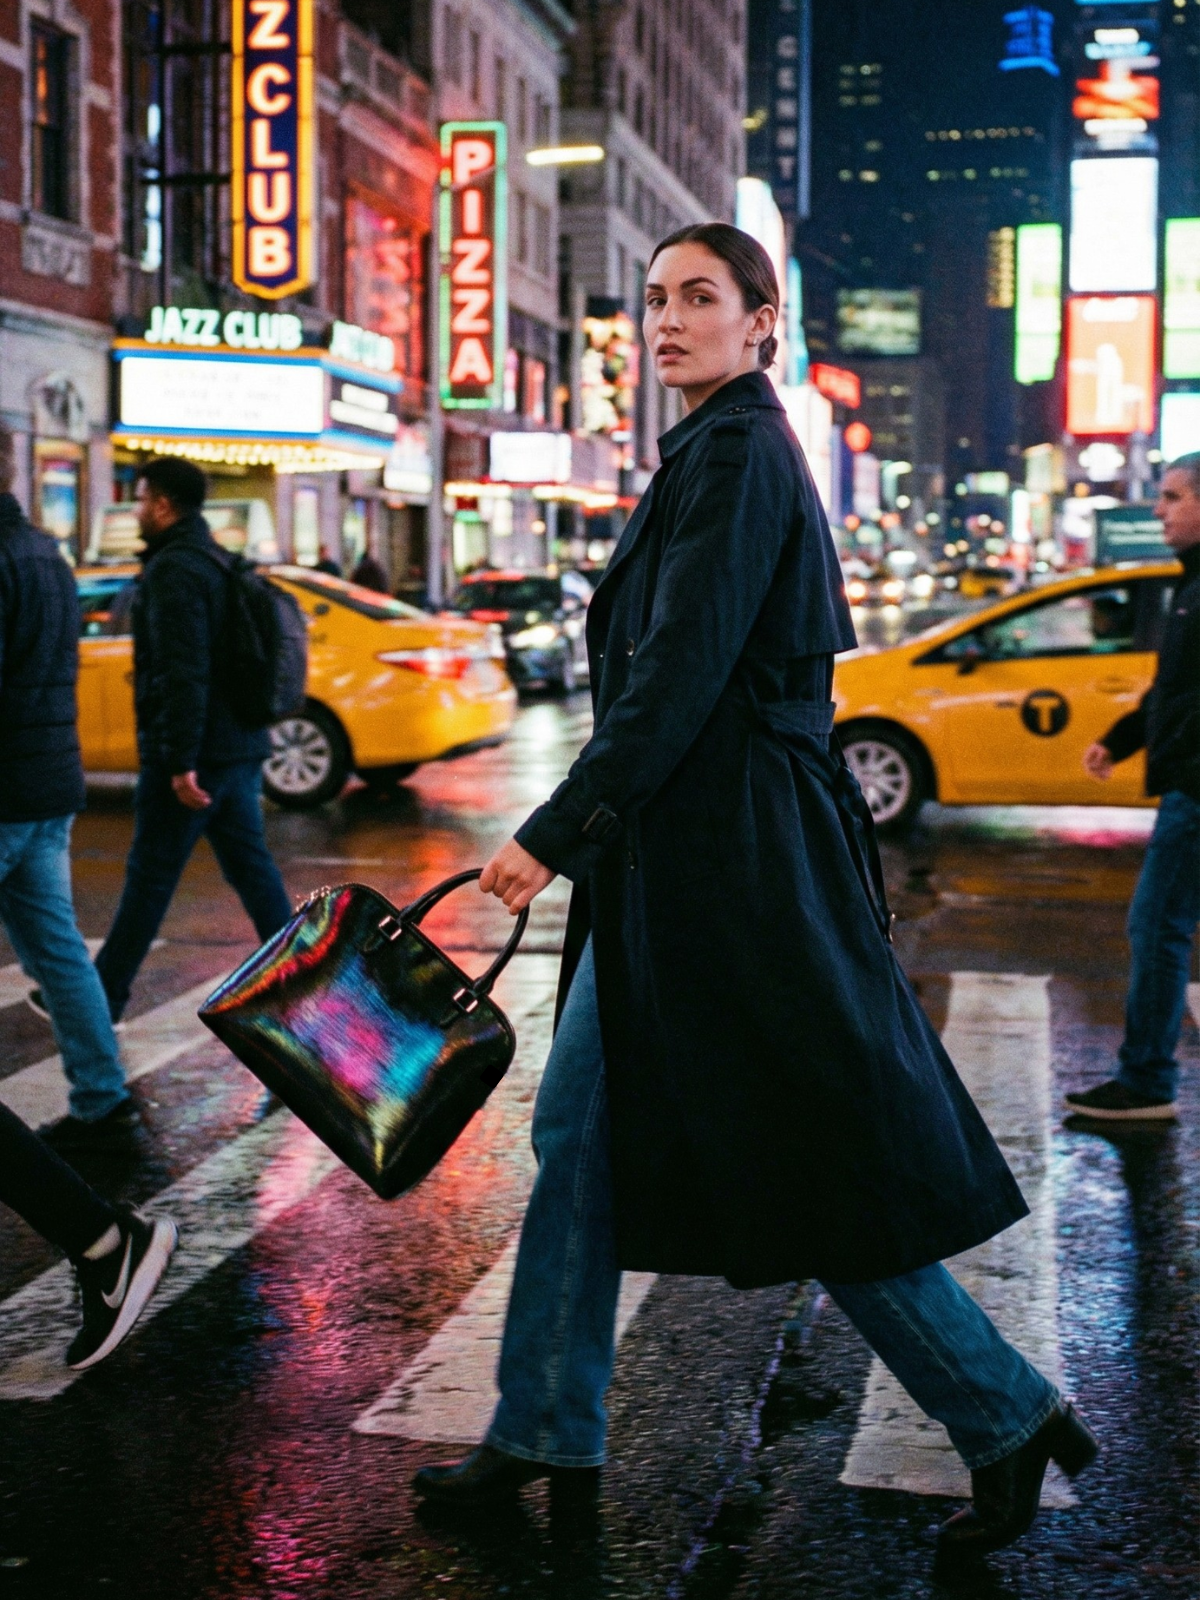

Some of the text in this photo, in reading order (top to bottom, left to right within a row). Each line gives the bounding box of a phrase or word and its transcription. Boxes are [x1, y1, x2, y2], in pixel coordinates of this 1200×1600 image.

[247, 62, 292, 277] CLUB
[450, 139, 494, 384] PIZZA
[145, 306, 221, 347] JAZZ
[223, 311, 302, 350] CLUB
[1029, 697, 1061, 732] T
